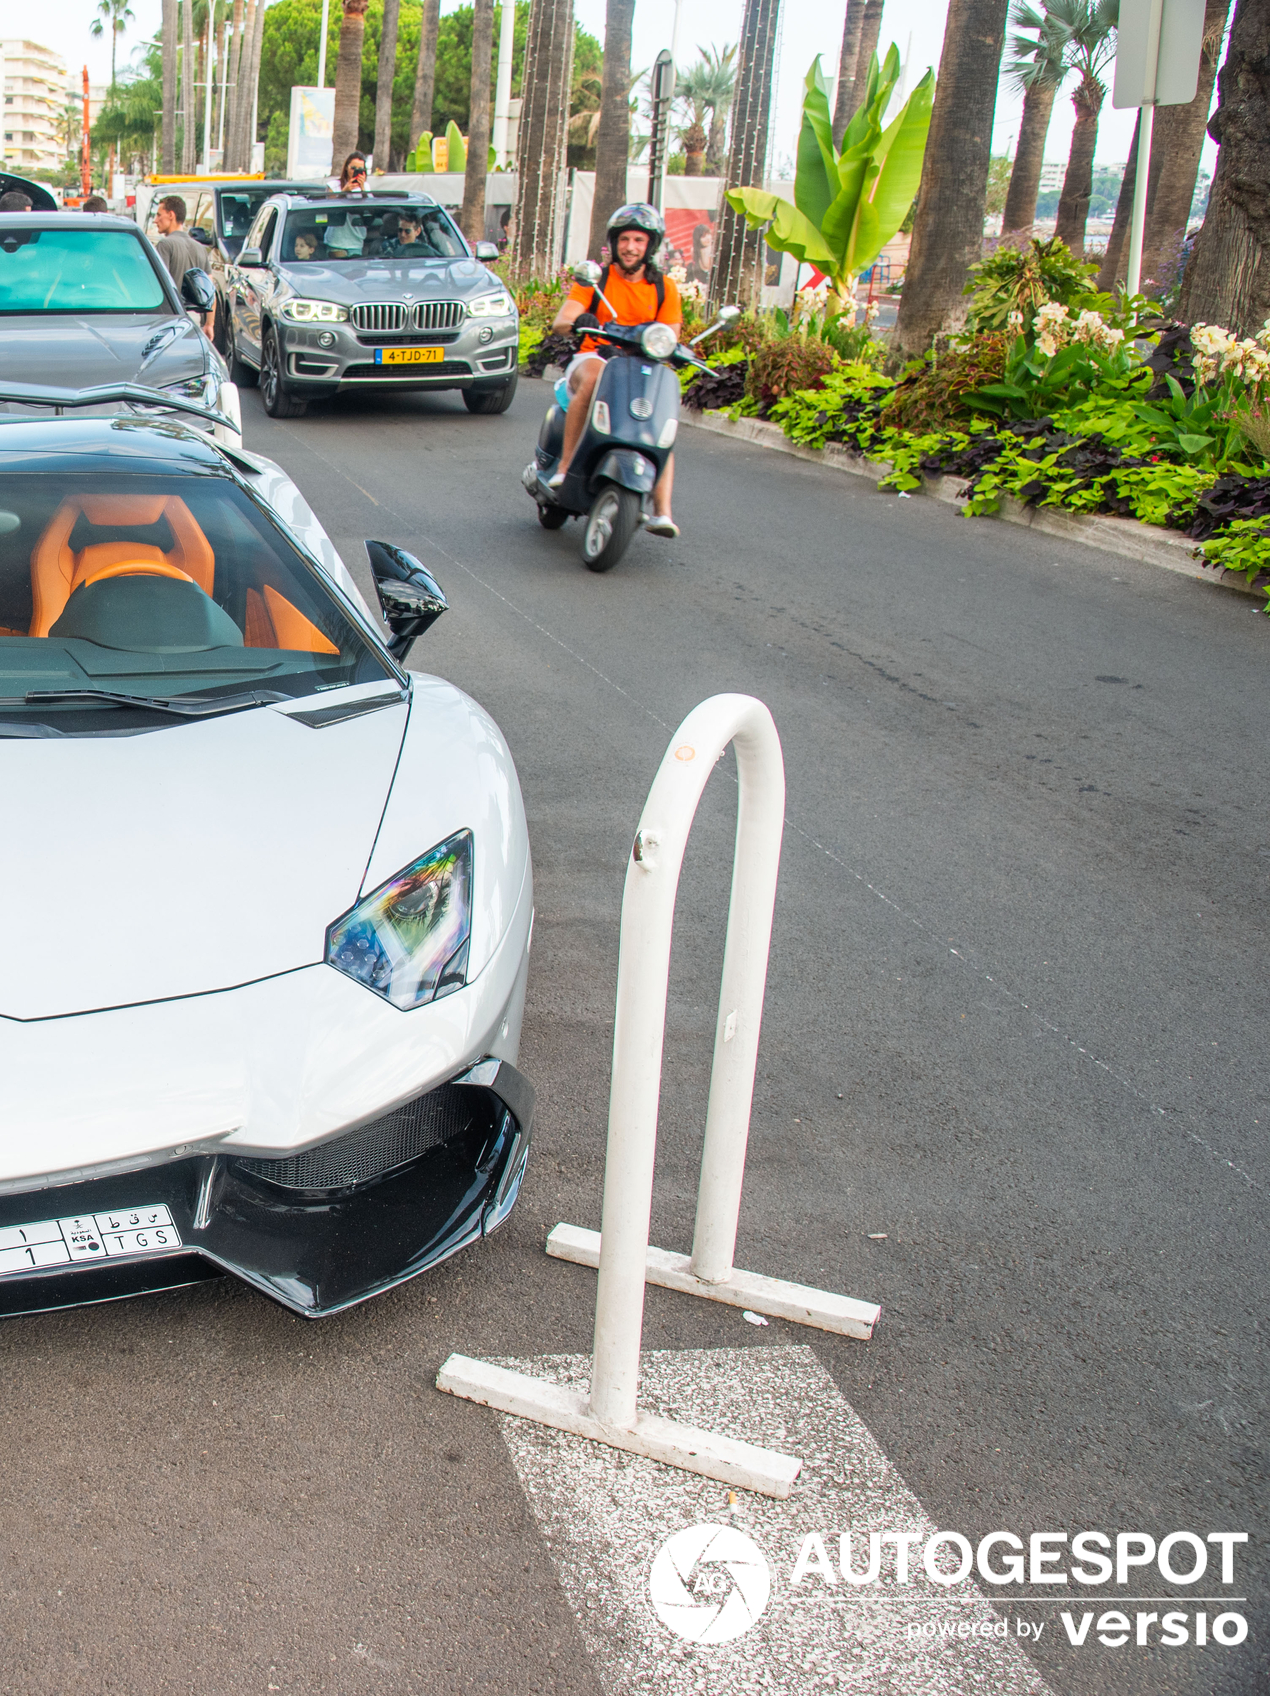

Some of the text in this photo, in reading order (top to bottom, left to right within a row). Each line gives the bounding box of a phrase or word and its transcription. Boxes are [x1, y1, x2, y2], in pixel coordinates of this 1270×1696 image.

[388, 350, 437, 361] 4-TJD-71
[71, 1234, 95, 1243] KSA
[25, 1247, 36, 1265] 1
